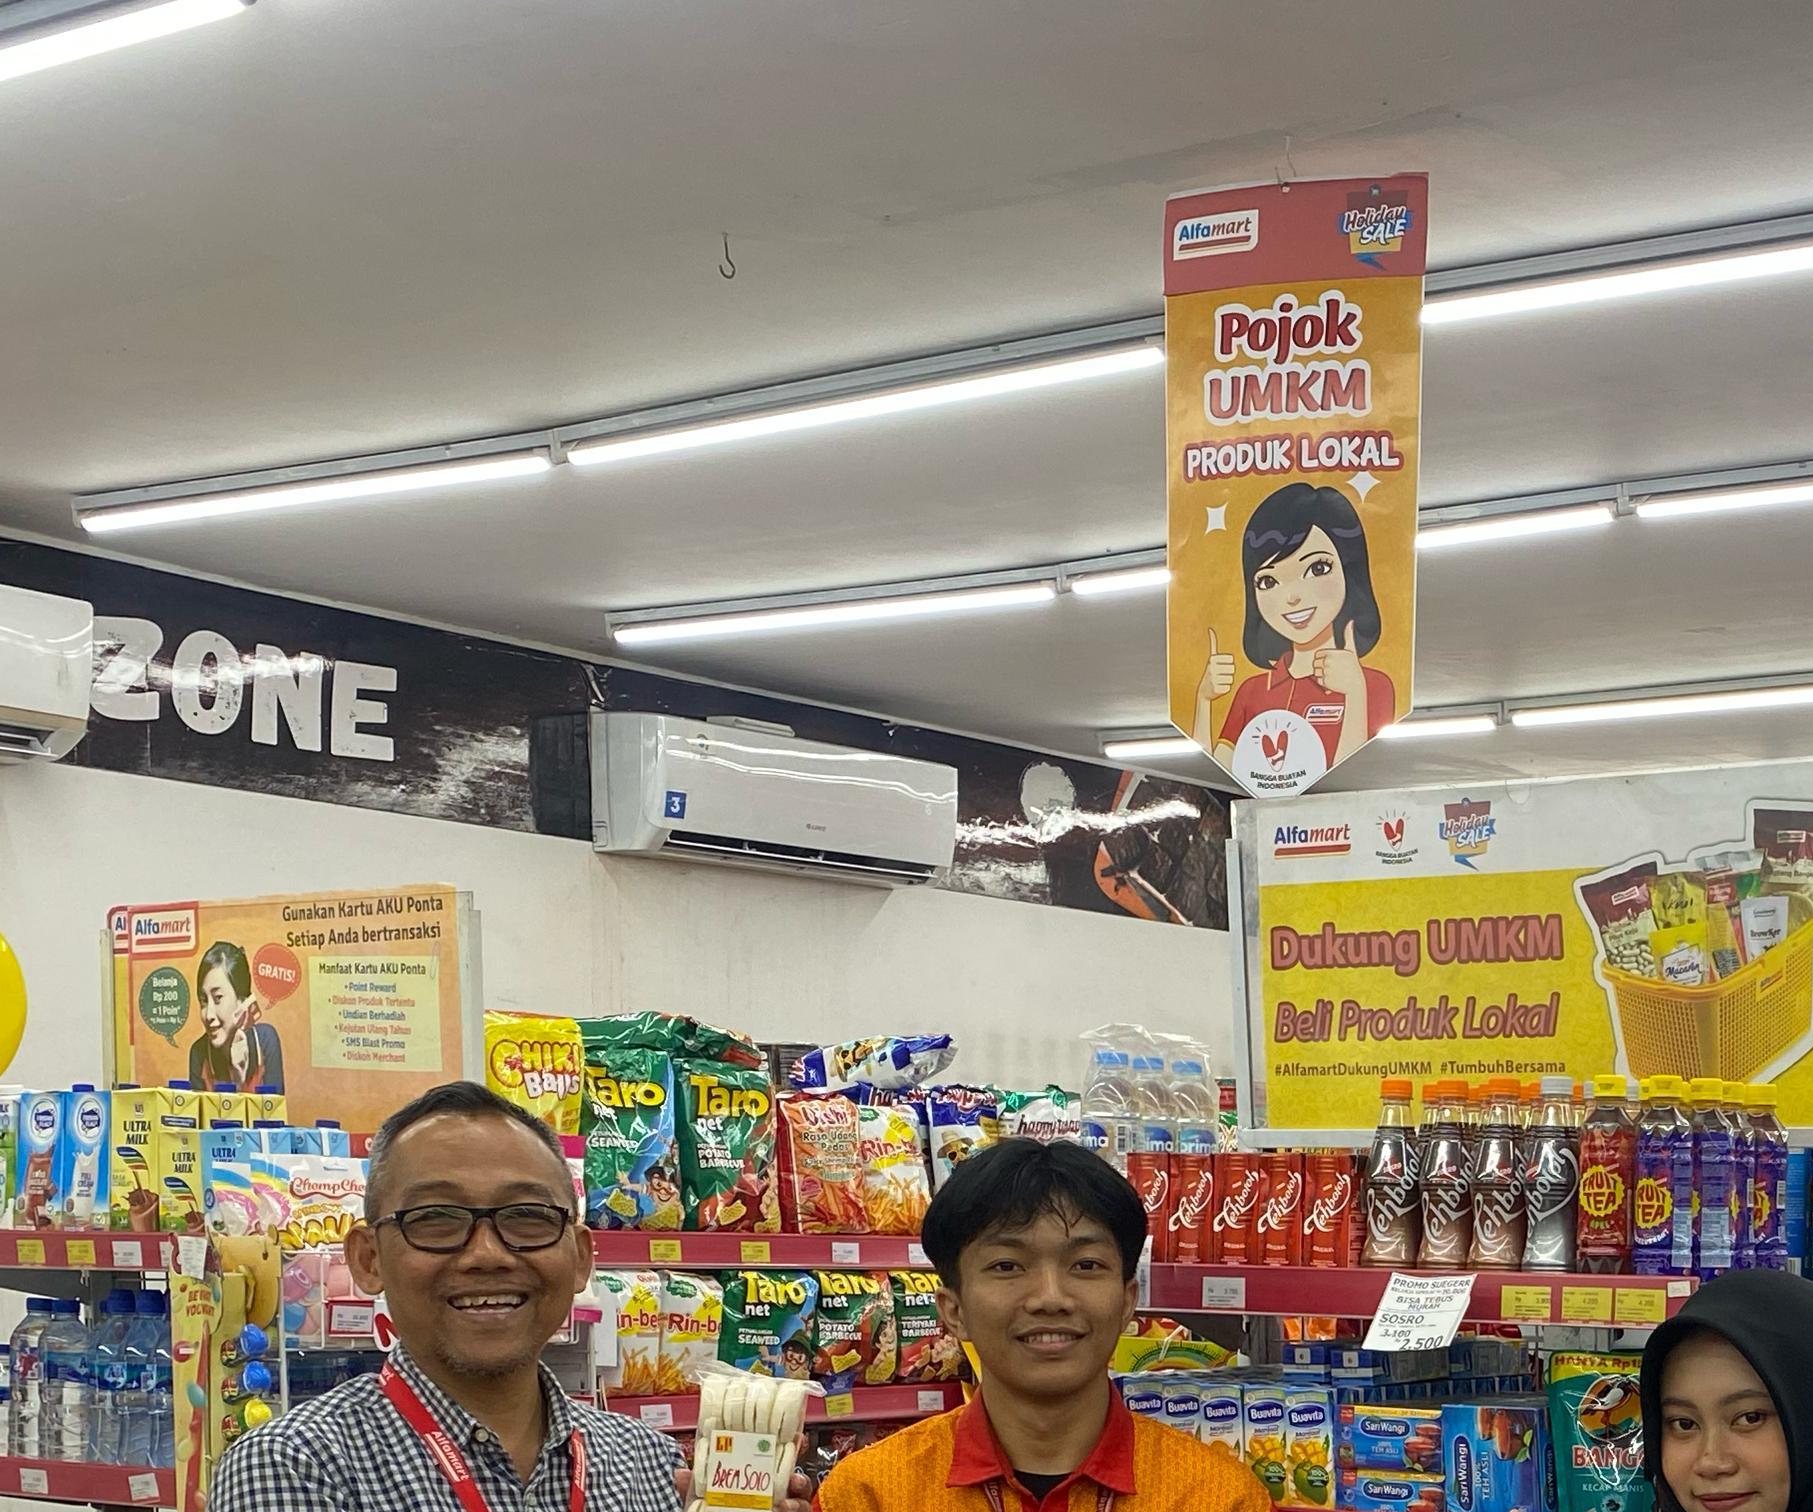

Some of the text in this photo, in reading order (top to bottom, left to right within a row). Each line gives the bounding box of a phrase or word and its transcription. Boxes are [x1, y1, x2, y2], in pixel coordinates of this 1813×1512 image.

[1177, 214, 1252, 243] Alfamart
[1344, 206, 1406, 234] Holiday
[1361, 219, 1406, 245] SALE
[1219, 297, 1358, 365] Pojok
[1208, 366, 1367, 418] UMKM
[1186, 434, 1401, 480] PRODUK LOKAL
[92, 616, 398, 762] ZONE
[1257, 780, 1299, 790] INDONESIA
[668, 796, 685, 815] 3
[1274, 823, 1351, 845] Alfamart
[1445, 814, 1490, 836] Holiday
[1457, 828, 1491, 848] SALE
[283, 895, 443, 922] Gunakan Kartu AKU Ponta
[135, 913, 192, 936] Alfamart
[286, 921, 441, 951] Setiap Anda bertransaksi
[1272, 914, 1563, 976] Dukung UMKM
[258, 963, 295, 983] GRATIS!
[319, 962, 426, 975] Manfaat Kartu AKU Ponta
[1274, 993, 1560, 1043] Beli Produk Lokal
[490, 1038, 581, 1090] CHIKI
[1274, 1058, 1566, 1078] #AlfamartDukungUMKM #TumbuhBersama
[524, 1070, 581, 1100] Balls
[587, 1065, 667, 1108] Taro
[690, 1075, 772, 1118] Taro
[123, 1121, 151, 1132] ULTRA
[697, 1116, 725, 1134] net
[125, 1133, 149, 1145] MILK
[802, 1131, 827, 1143] Rasa
[172, 1151, 196, 1163] ULTRA
[173, 1162, 193, 1174] MILK
[1582, 1171, 1619, 1190] FRUIT
[1583, 1191, 1617, 1210] TEA
[740, 1270, 808, 1305] Taro
[1393, 1278, 1430, 1290] PROMO
[822, 1296, 849, 1309] net
[904, 1294, 929, 1307] net
[744, 1304, 771, 1317] net
[1379, 1313, 1426, 1325] SOSRO
[818, 1322, 855, 1333] POTATO
[818, 1331, 862, 1342] BARBECUE
[737, 1334, 781, 1346] SEAWEED
[1400, 1334, 1445, 1351] 2.500
[1129, 1399, 1162, 1412] Buavita
[1167, 1401, 1199, 1413] Buavita
[1206, 1404, 1237, 1417] Buavita
[1250, 1406, 1283, 1420] Buavita
[1291, 1409, 1324, 1423] Buavita
[1365, 1419, 1407, 1436] SariWangi
[430, 1430, 470, 1483] Alfamart
[1458, 1442, 1471, 1504] SariWangi
[1482, 1450, 1491, 1501] TEH ASLI
[1366, 1482, 1410, 1498] SariWangi
[1581, 1483, 1645, 1493] KECAP MANIS
